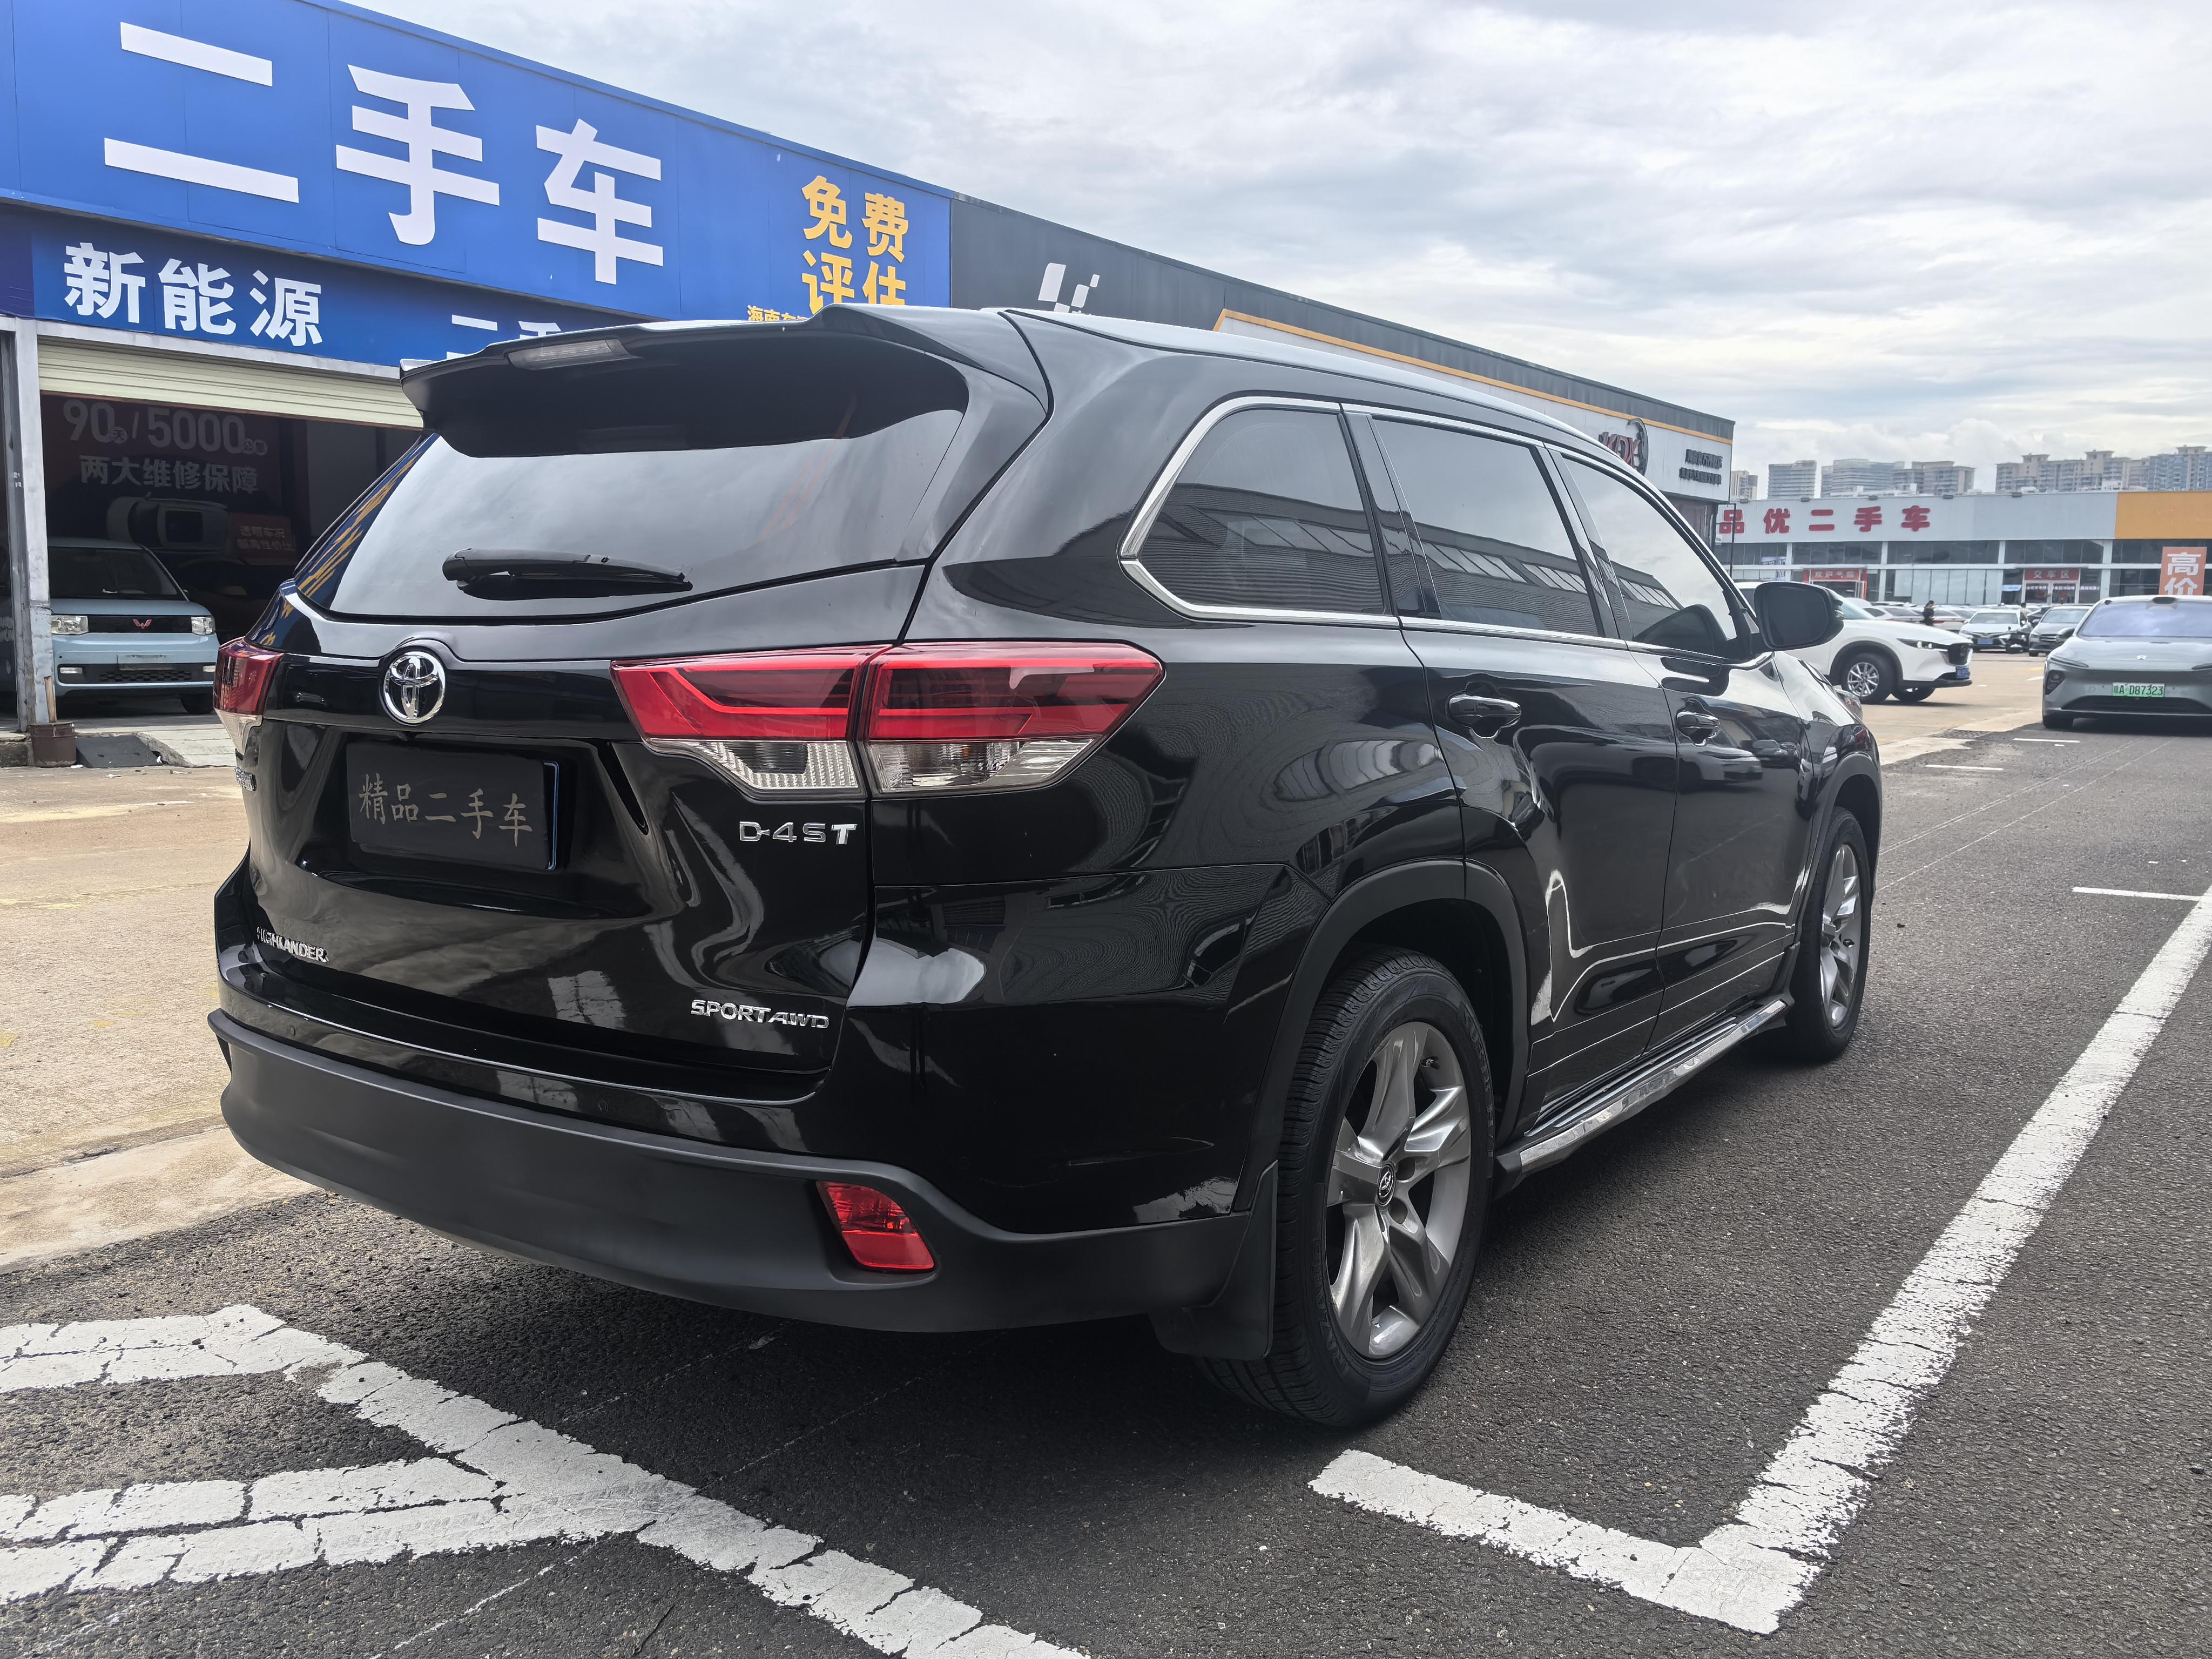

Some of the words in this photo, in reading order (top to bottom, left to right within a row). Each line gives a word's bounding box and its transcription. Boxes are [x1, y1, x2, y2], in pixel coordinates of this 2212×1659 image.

[104, 22, 664, 285] 二手车
[802, 175, 908, 263] 免费
[64, 242, 323, 346] 新能源
[802, 250, 906, 315] 评估
[79, 455, 258, 494] 两大维修保障
[1719, 505, 1931, 534] 品优二手车
[2033, 570, 2069, 579] 交车区
[2164, 552, 2202, 595] 高价
[359, 773, 533, 847] 精品二手车
[257, 926, 329, 963] HIGHLANDER
